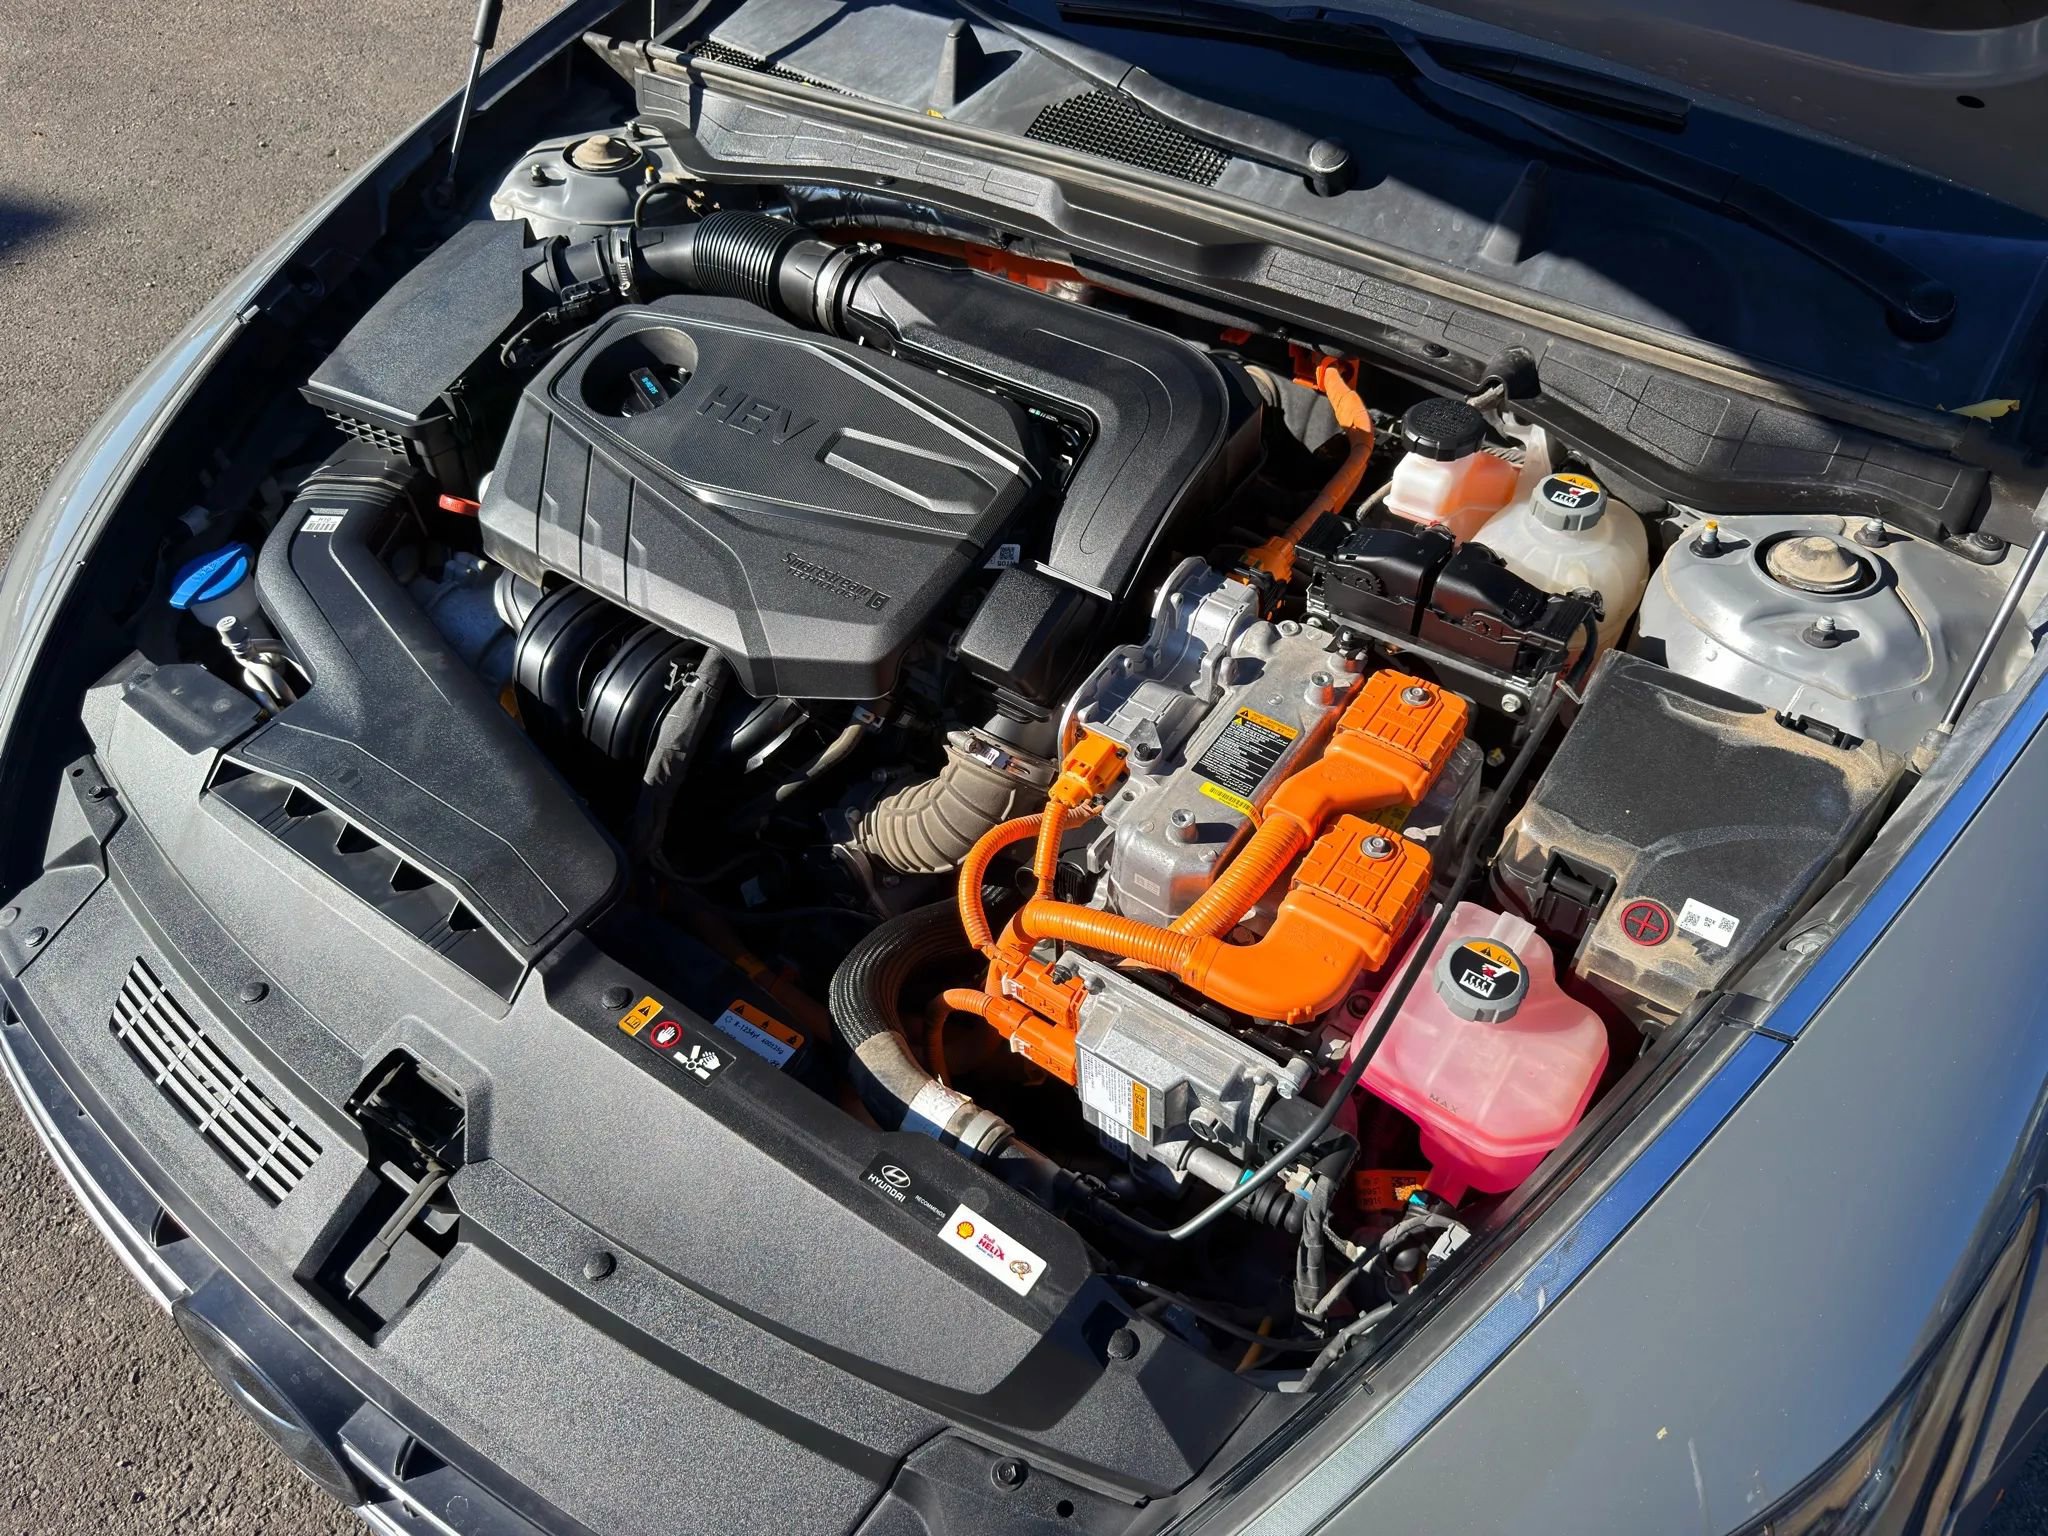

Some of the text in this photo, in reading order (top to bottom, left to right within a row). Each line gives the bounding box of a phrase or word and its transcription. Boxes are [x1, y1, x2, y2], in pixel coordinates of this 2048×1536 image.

[696, 384, 820, 445] HEV
[781, 552, 873, 597] Smartstream
[787, 566, 862, 601] TECHNOLOGY
[867, 1173, 906, 1203] HYUNDAI
[915, 1194, 946, 1219] RECOMMENDS
[978, 1239, 1006, 1261] HELIX
[983, 1233, 996, 1244] Shell
